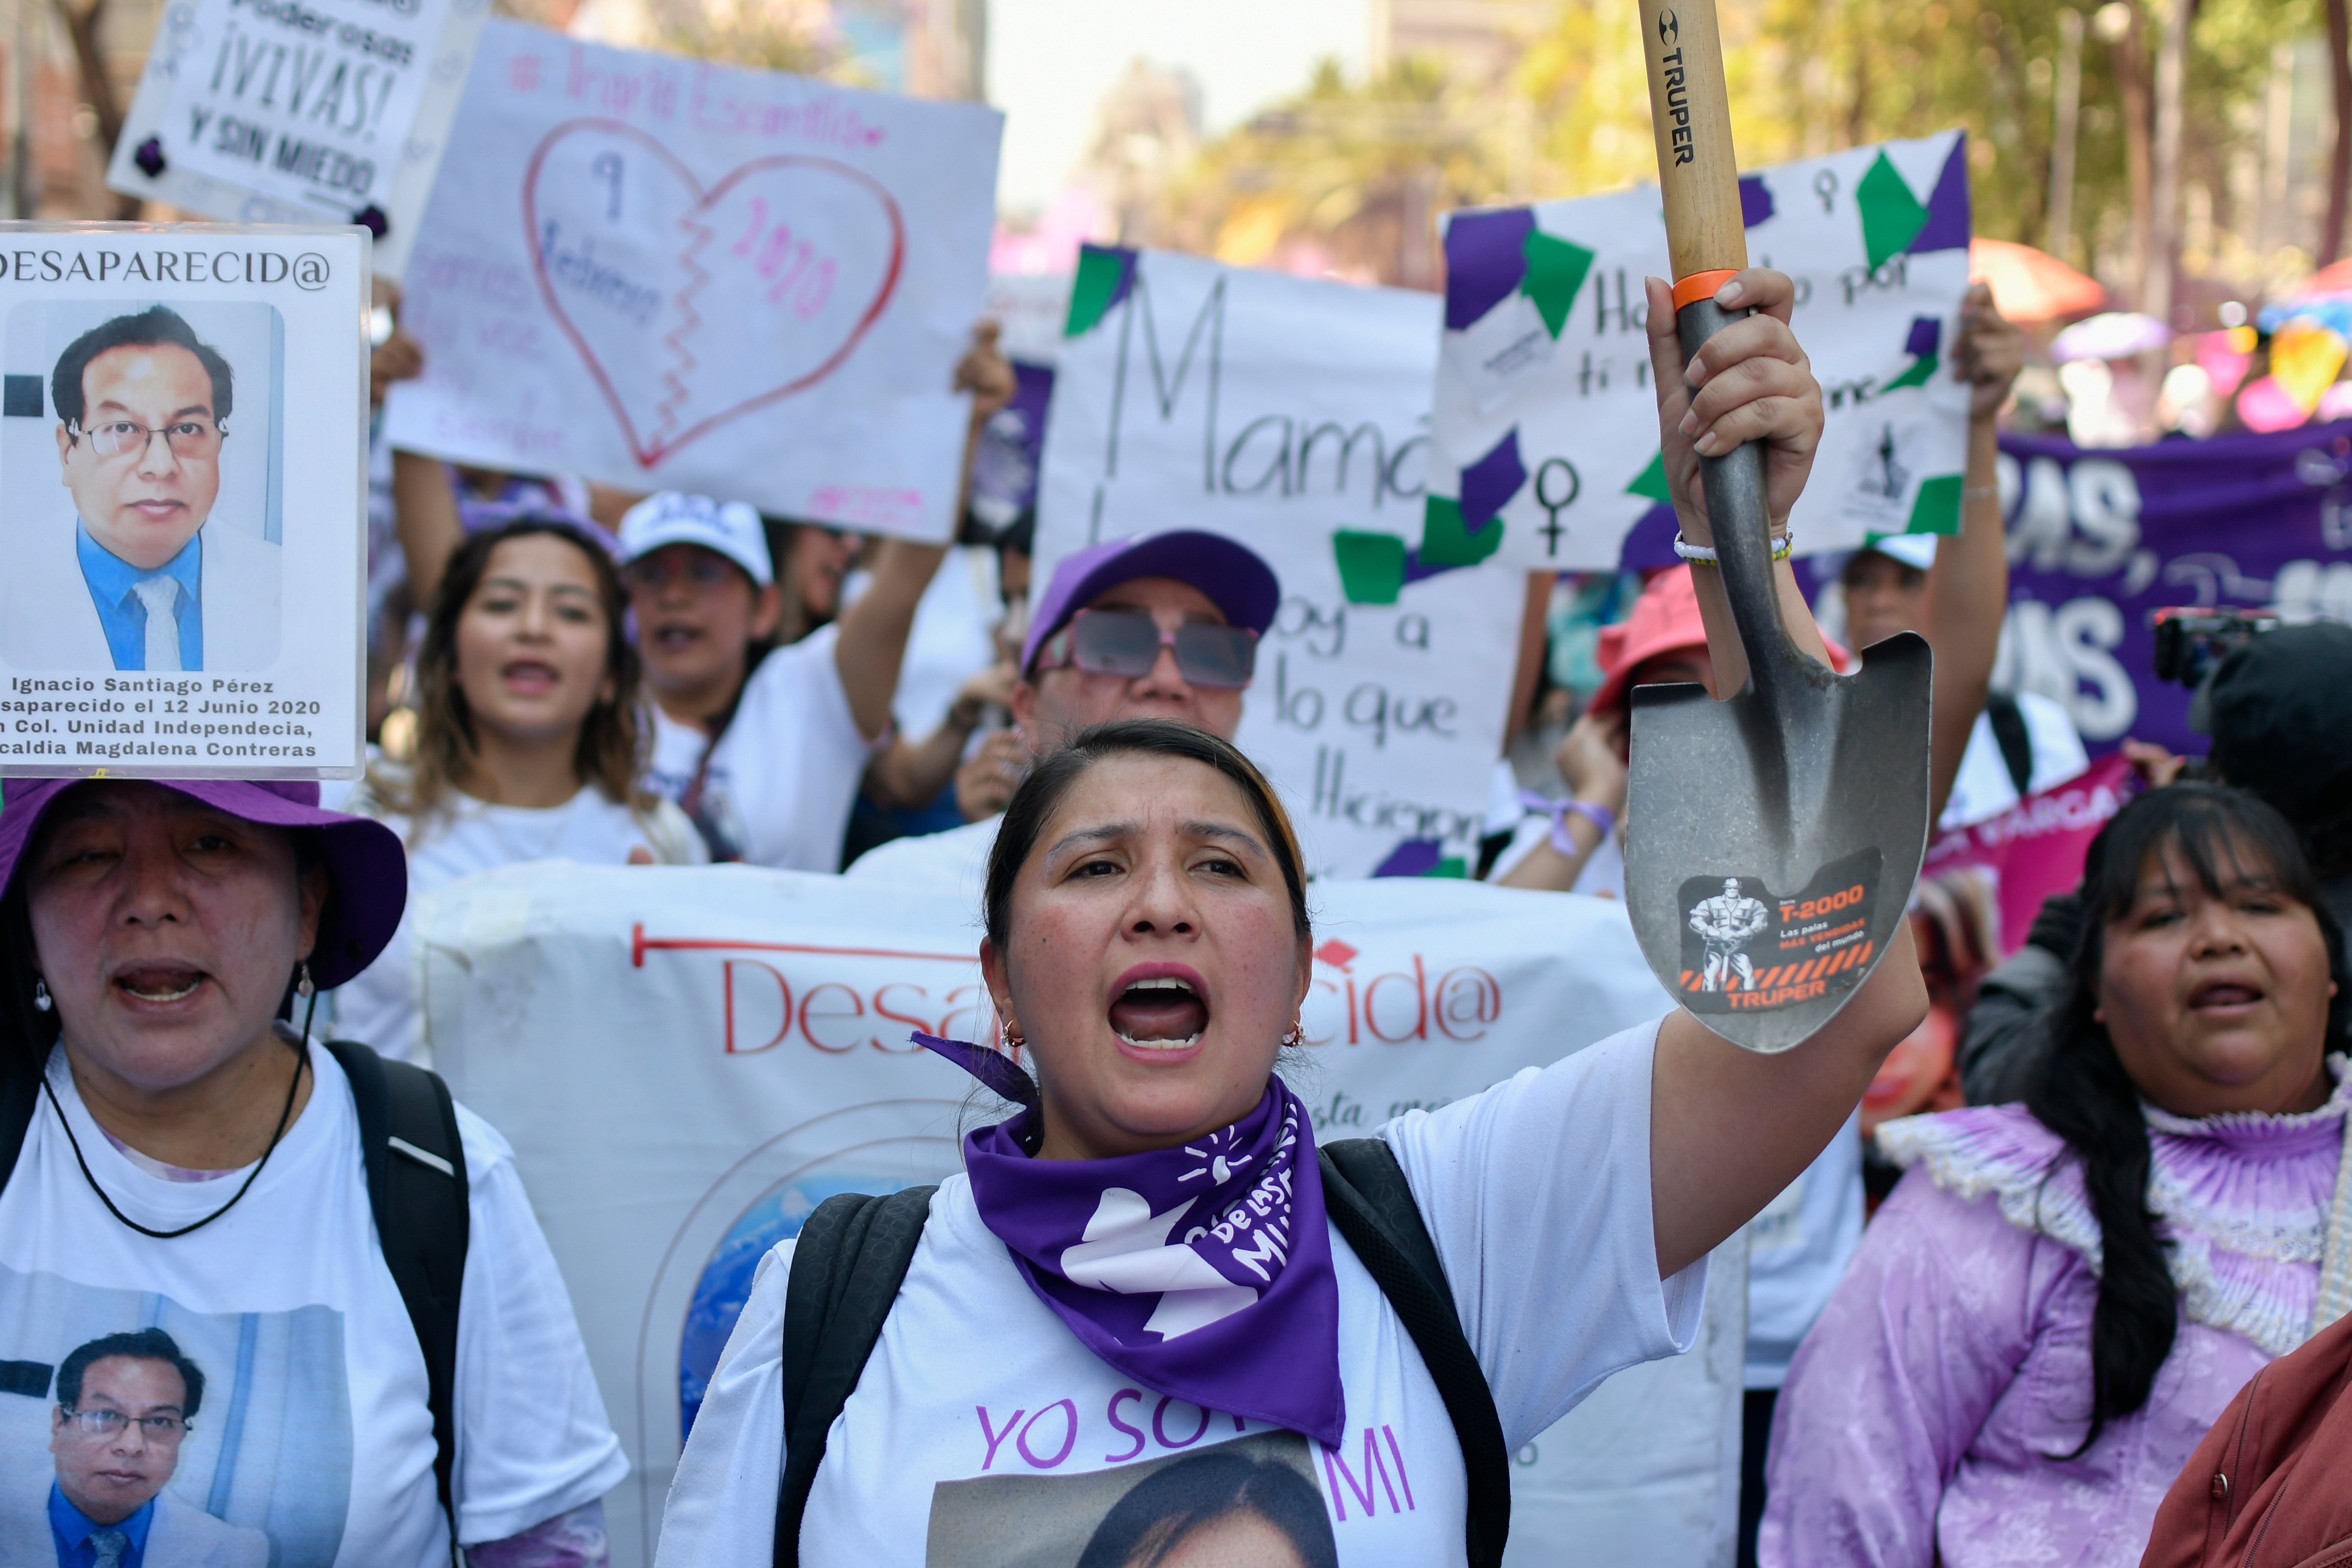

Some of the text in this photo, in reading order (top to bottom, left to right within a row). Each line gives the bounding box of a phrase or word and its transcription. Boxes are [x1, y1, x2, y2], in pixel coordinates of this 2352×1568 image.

[229, 0, 416, 67] oderosas
[1663, 47, 1694, 168] TRUPER
[188, 104, 376, 196] Y SIN MIEDO
[0, 250, 329, 291] ESAPARECID@
[1276, 595, 1430, 660] oy a
[1, 698, 321, 715] saparecido el 12 Junio 2020
[12, 677, 274, 696] Ignacio Santiago Pérez
[1275, 650, 1459, 749] lo que
[15, 719, 57, 733] Col.
[68, 719, 144, 733] Unidad
[155, 720, 313, 738] Independecia,
[76, 740, 197, 759] Magdalena
[207, 741, 317, 757] Contreras
[1779, 884, 1865, 923] T-2000
[1780, 921, 1828, 939] Las palas
[1814, 930, 1865, 953] del mundo
[1727, 979, 1826, 1009] TRUPER
[1310, 1090, 1368, 1131] sta
[976, 1397, 1078, 1471] YO
[1320, 1424, 1415, 1522] MI
